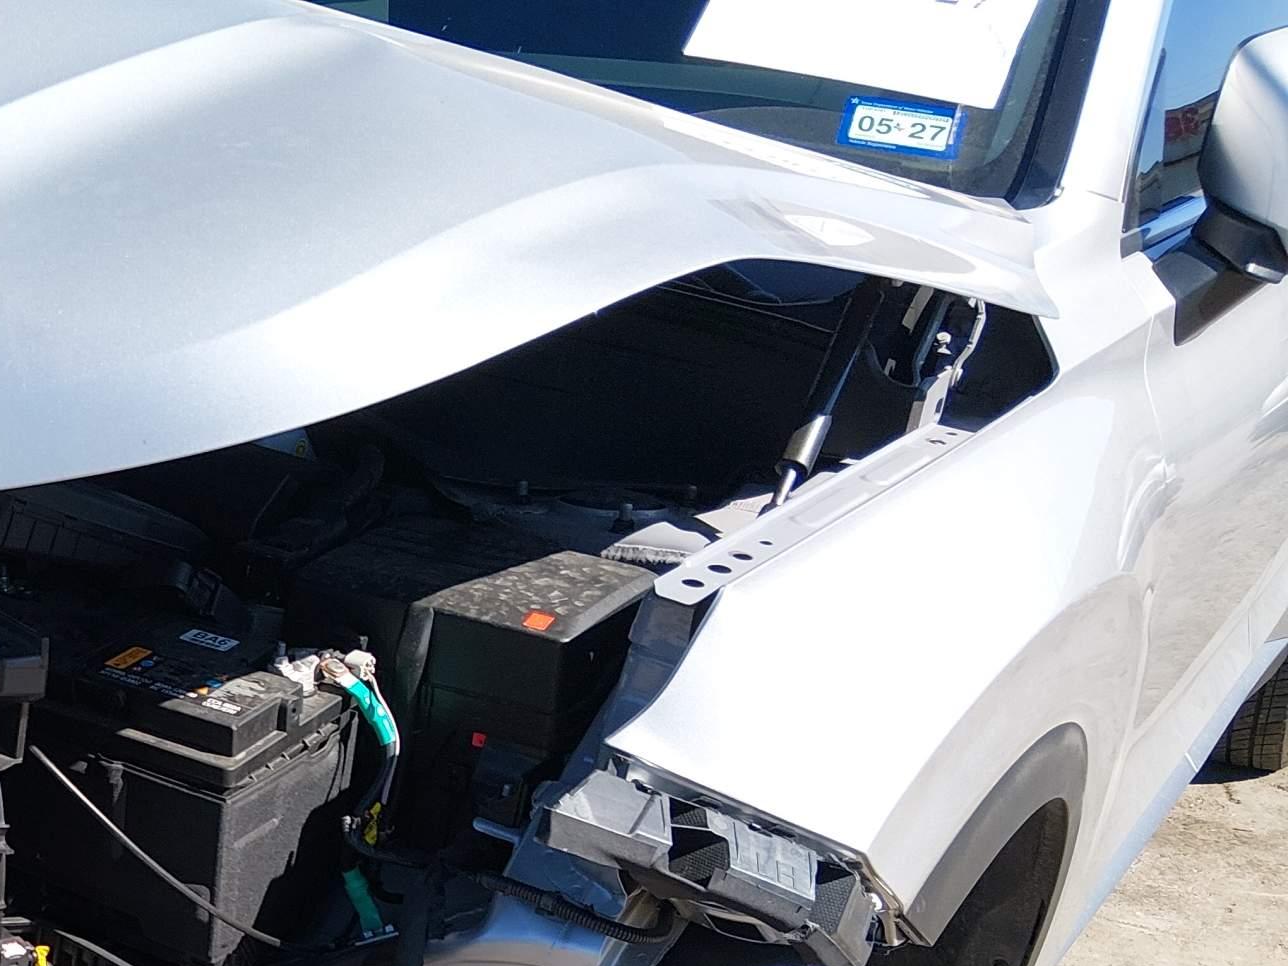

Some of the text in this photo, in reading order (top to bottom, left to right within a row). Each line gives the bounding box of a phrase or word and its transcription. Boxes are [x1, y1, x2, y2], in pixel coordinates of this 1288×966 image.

[858, 115, 893, 134] 05
[908, 122, 947, 141] 27
[193, 632, 229, 646] BA6
